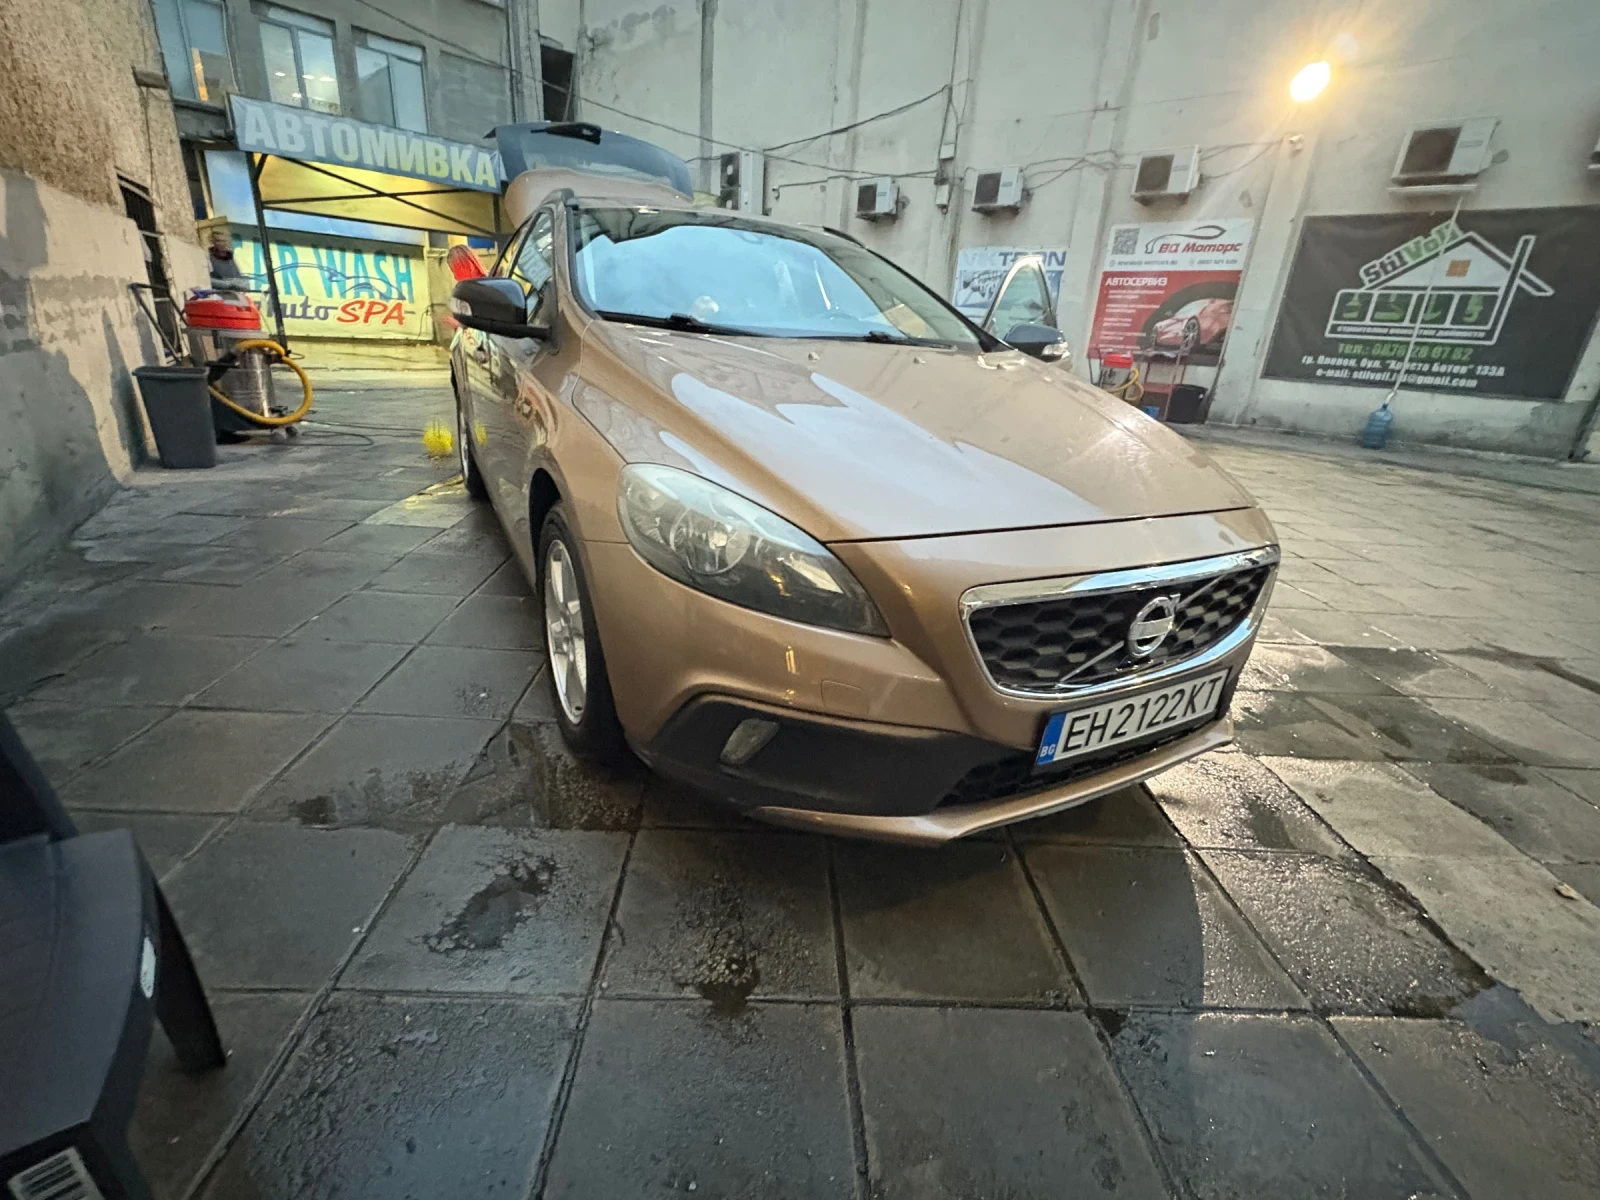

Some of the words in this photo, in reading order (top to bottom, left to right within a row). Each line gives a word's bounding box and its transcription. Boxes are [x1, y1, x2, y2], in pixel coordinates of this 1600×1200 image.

[244, 104, 497, 188] АВТОМИВКА
[1182, 242, 1243, 254] Моторс
[231, 234, 304, 296] AR
[312, 243, 415, 304] WASH
[1105, 277, 1168, 287] АВТОСЕРВИЗ
[337, 299, 406, 326] SPA
[1061, 676, 1223, 753] EH2122KT
[1040, 743, 1056, 757] BG
